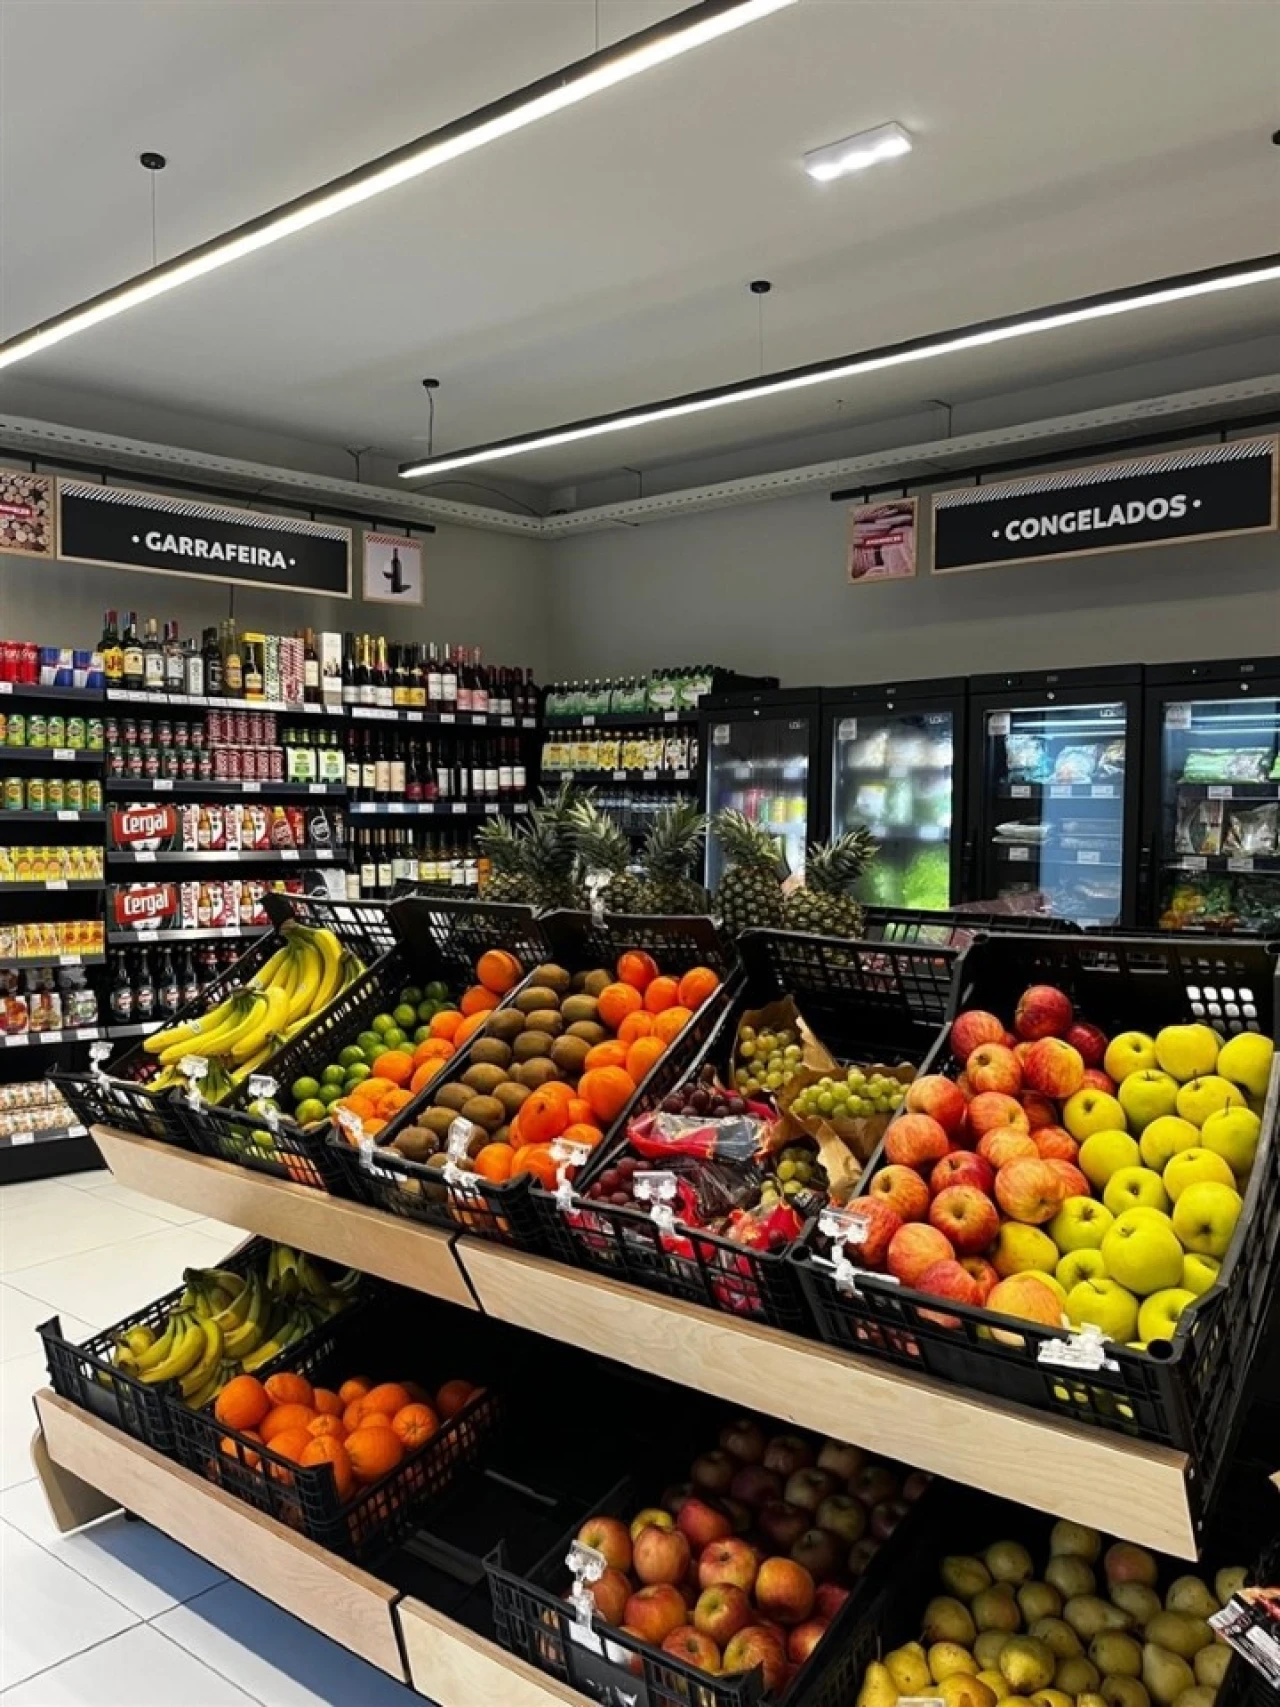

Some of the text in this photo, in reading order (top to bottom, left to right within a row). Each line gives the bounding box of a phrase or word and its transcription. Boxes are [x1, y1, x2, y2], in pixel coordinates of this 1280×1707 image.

[1004, 493, 1188, 542] CONGELADOS
[145, 531, 287, 570] GARRAFEIRA
[122, 809, 168, 836] Cergal
[123, 888, 170, 915] Cergal
